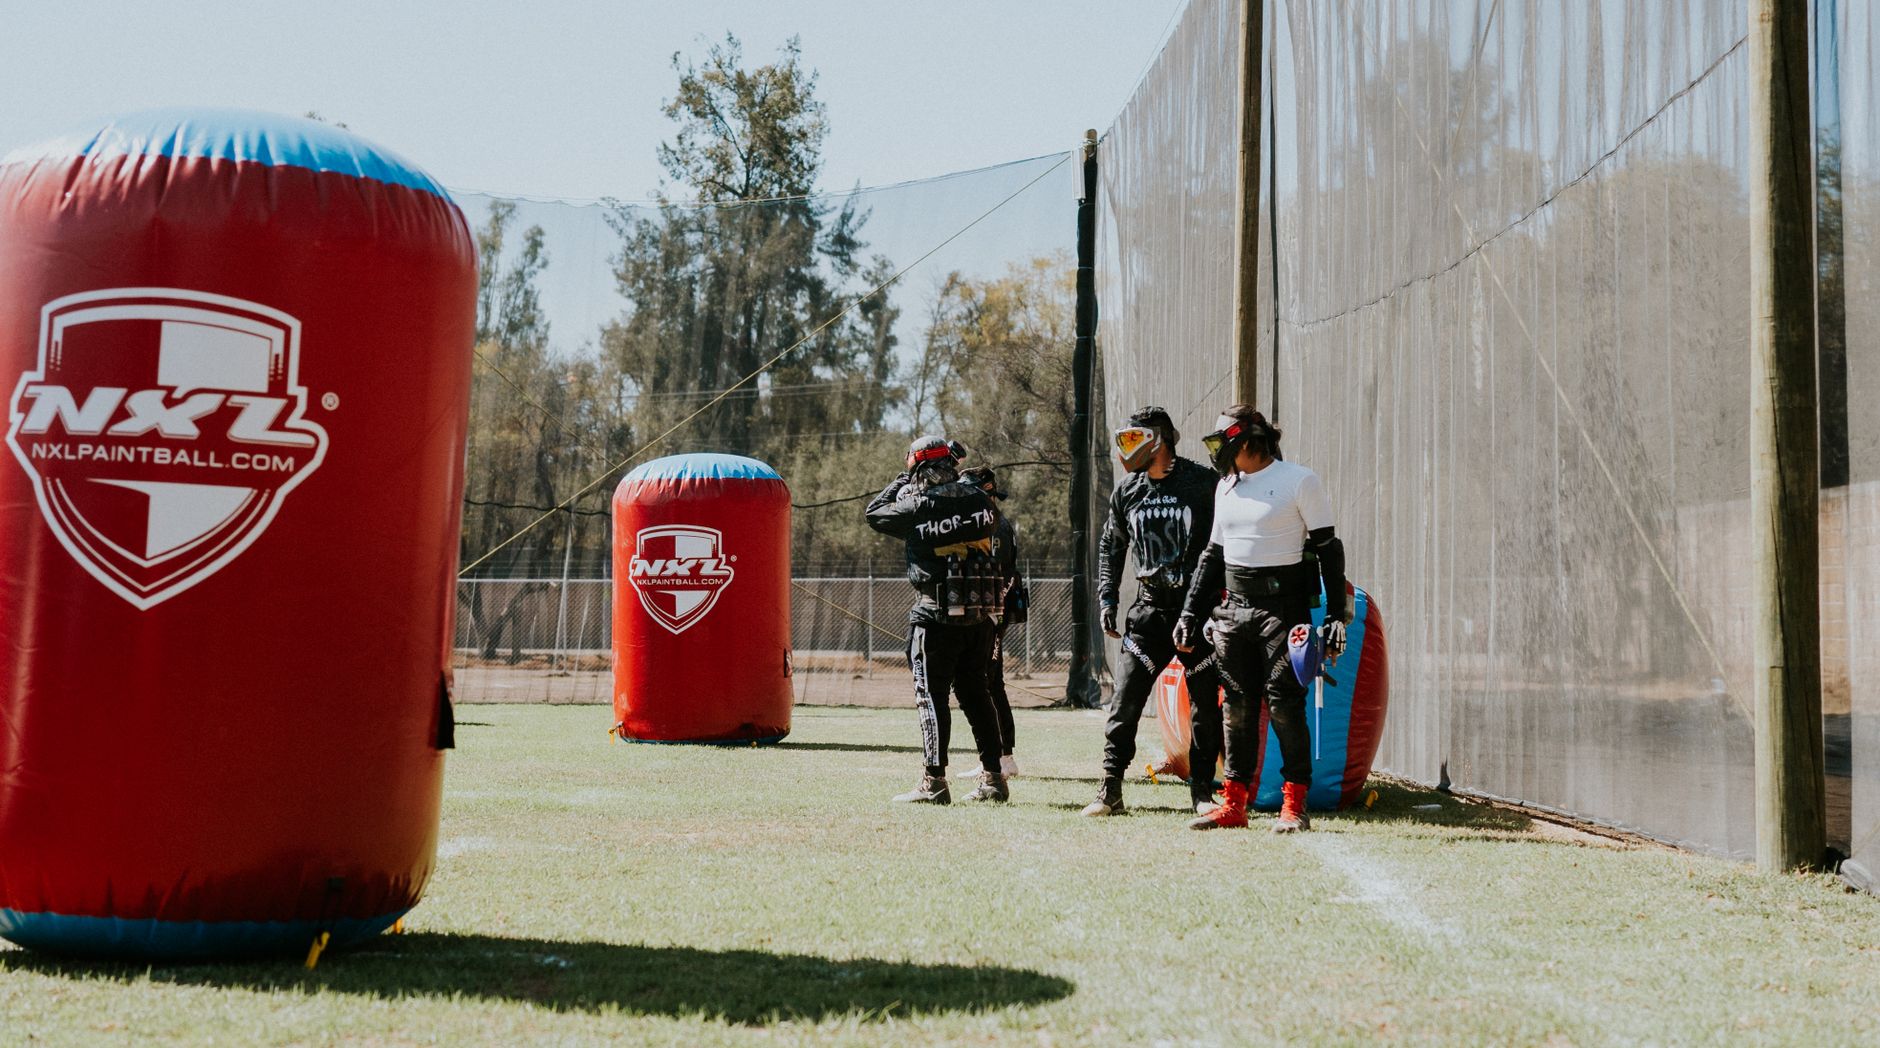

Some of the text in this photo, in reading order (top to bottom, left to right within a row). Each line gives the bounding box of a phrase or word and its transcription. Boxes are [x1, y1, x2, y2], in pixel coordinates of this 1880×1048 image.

[21, 385, 317, 448] NXL
[31, 442, 295, 472] NXLPAINTBALL.COM
[633, 558, 730, 577] NXL
[636, 578, 724, 586] NXLPAINTBALL.COM
